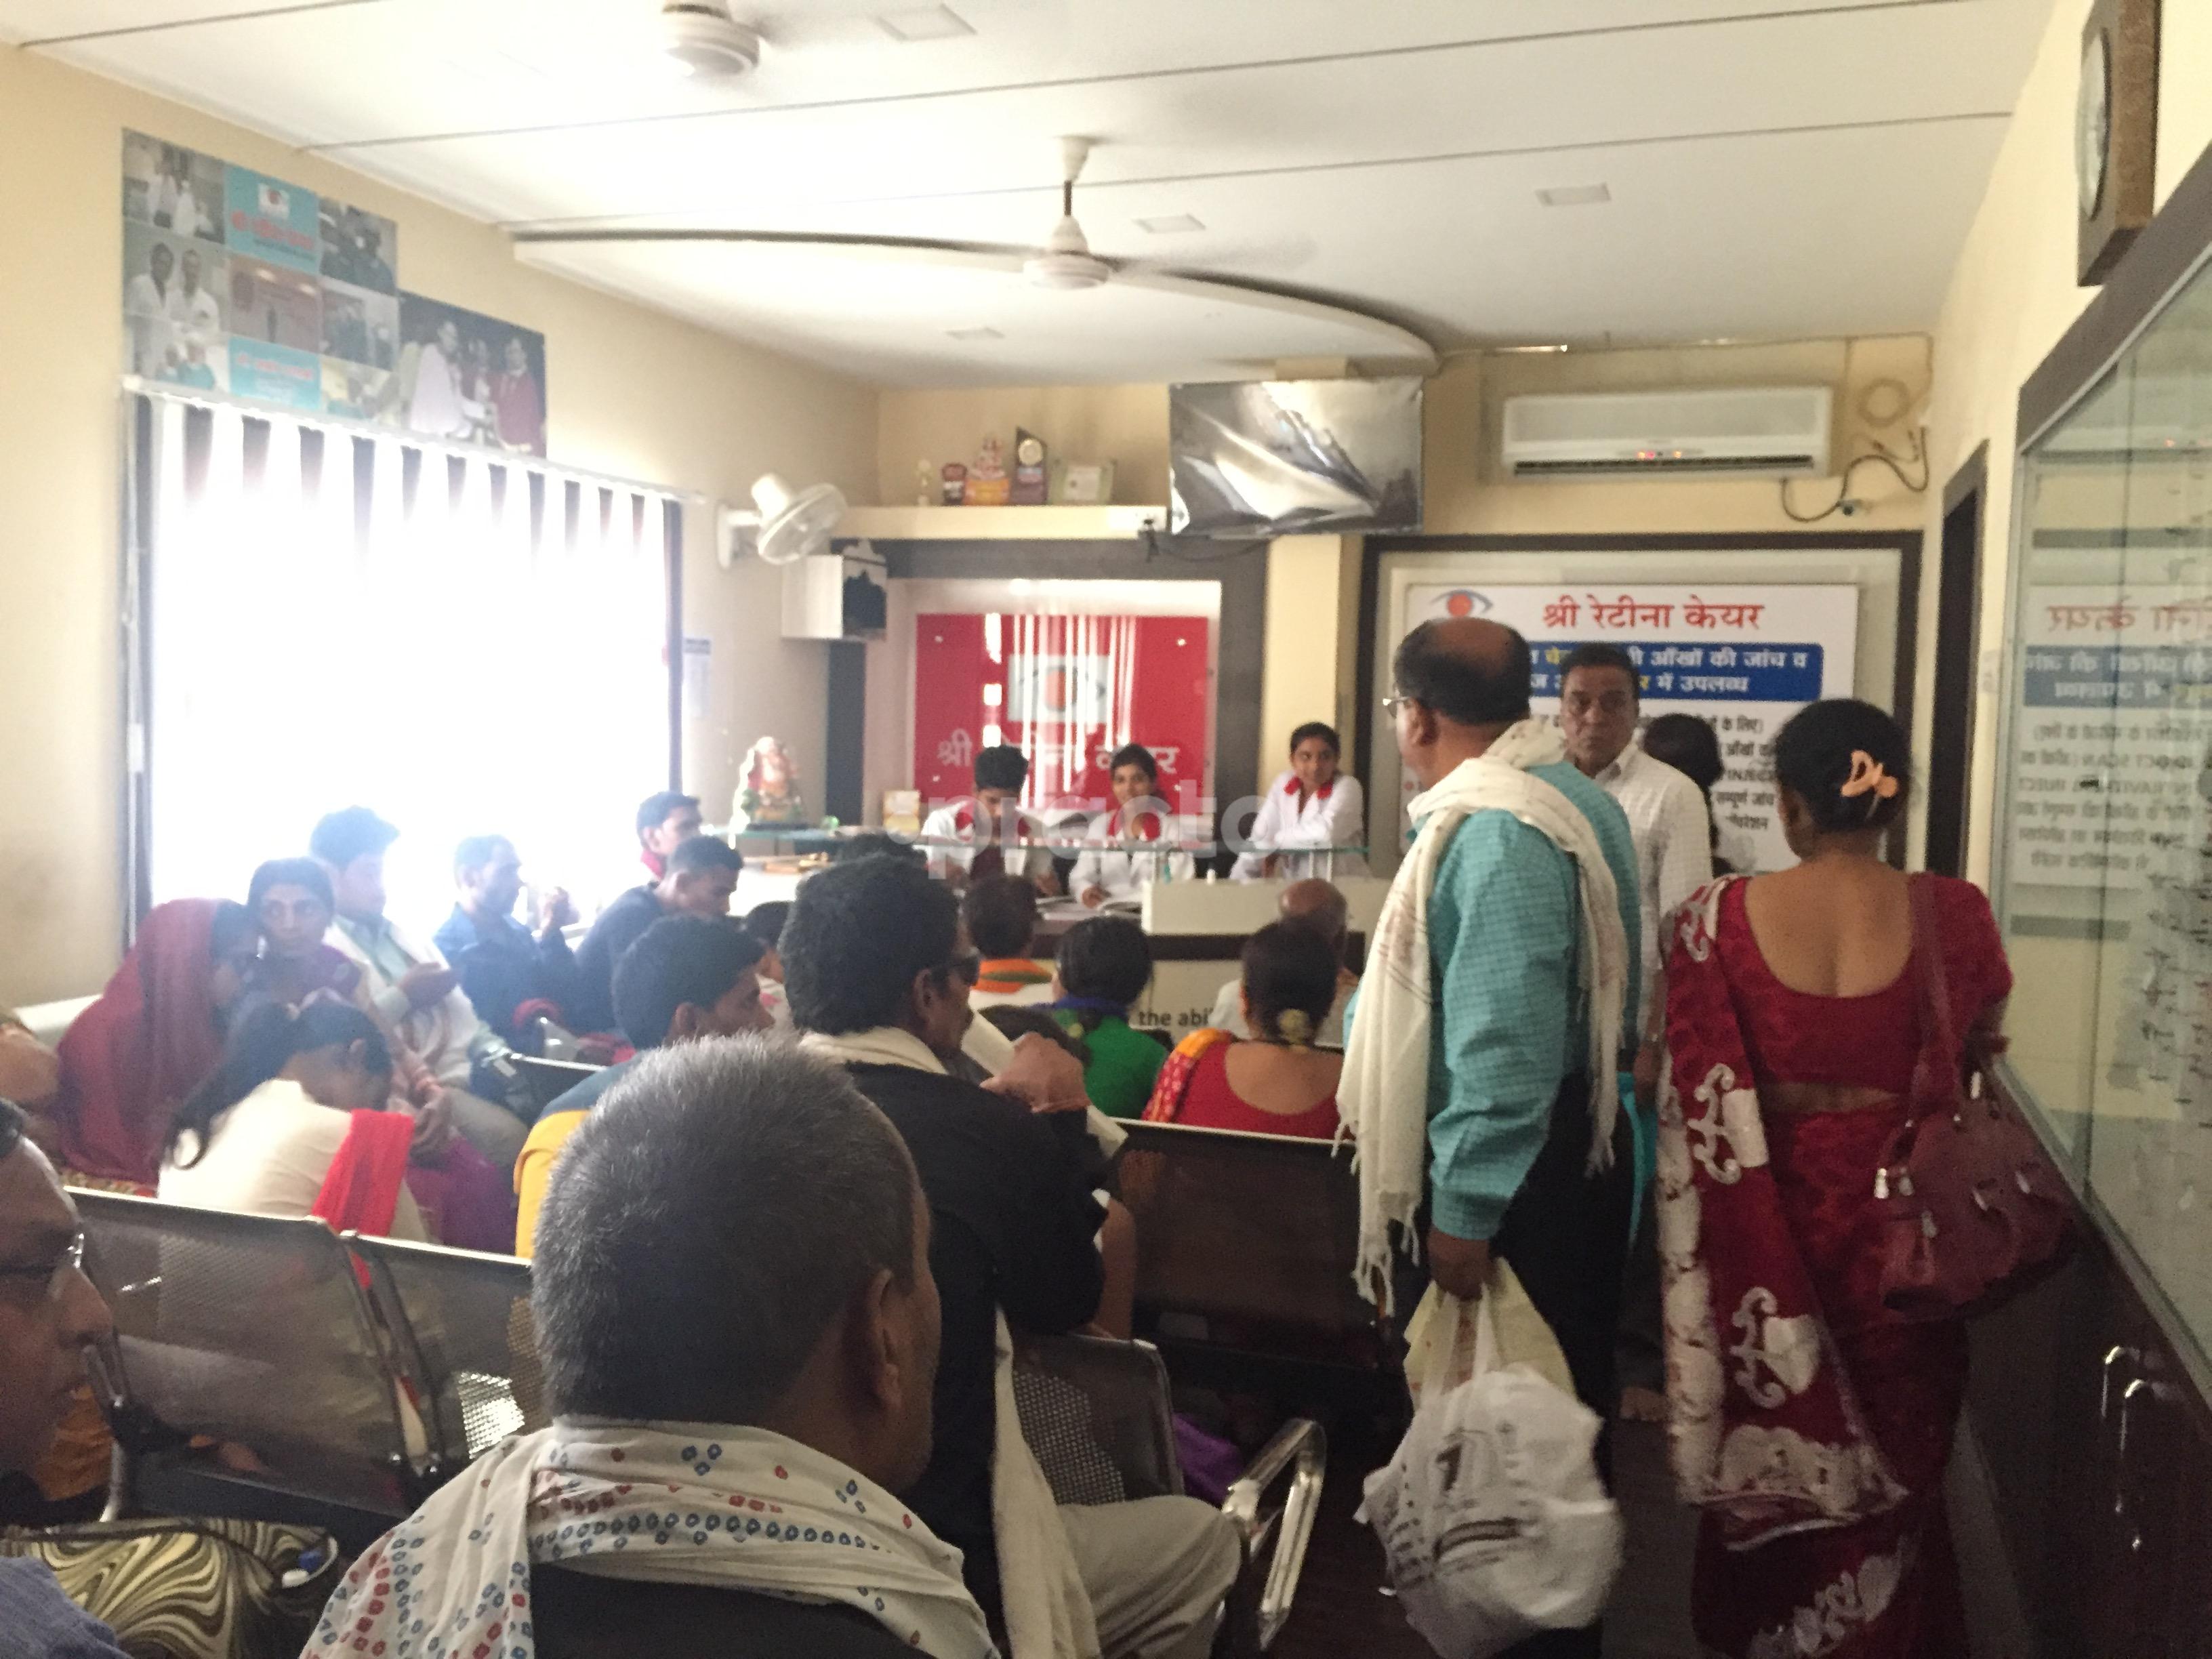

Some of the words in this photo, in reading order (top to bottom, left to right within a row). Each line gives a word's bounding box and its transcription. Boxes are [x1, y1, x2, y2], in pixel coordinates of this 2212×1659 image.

[1542, 594, 1580, 628] श्री
[1586, 594, 1675, 629] रेटीना
[1683, 594, 1765, 629] केयर
[1709, 646, 1737, 668] की
[1656, 672, 1674, 691] में
[1138, 1008, 1172, 1026] the
